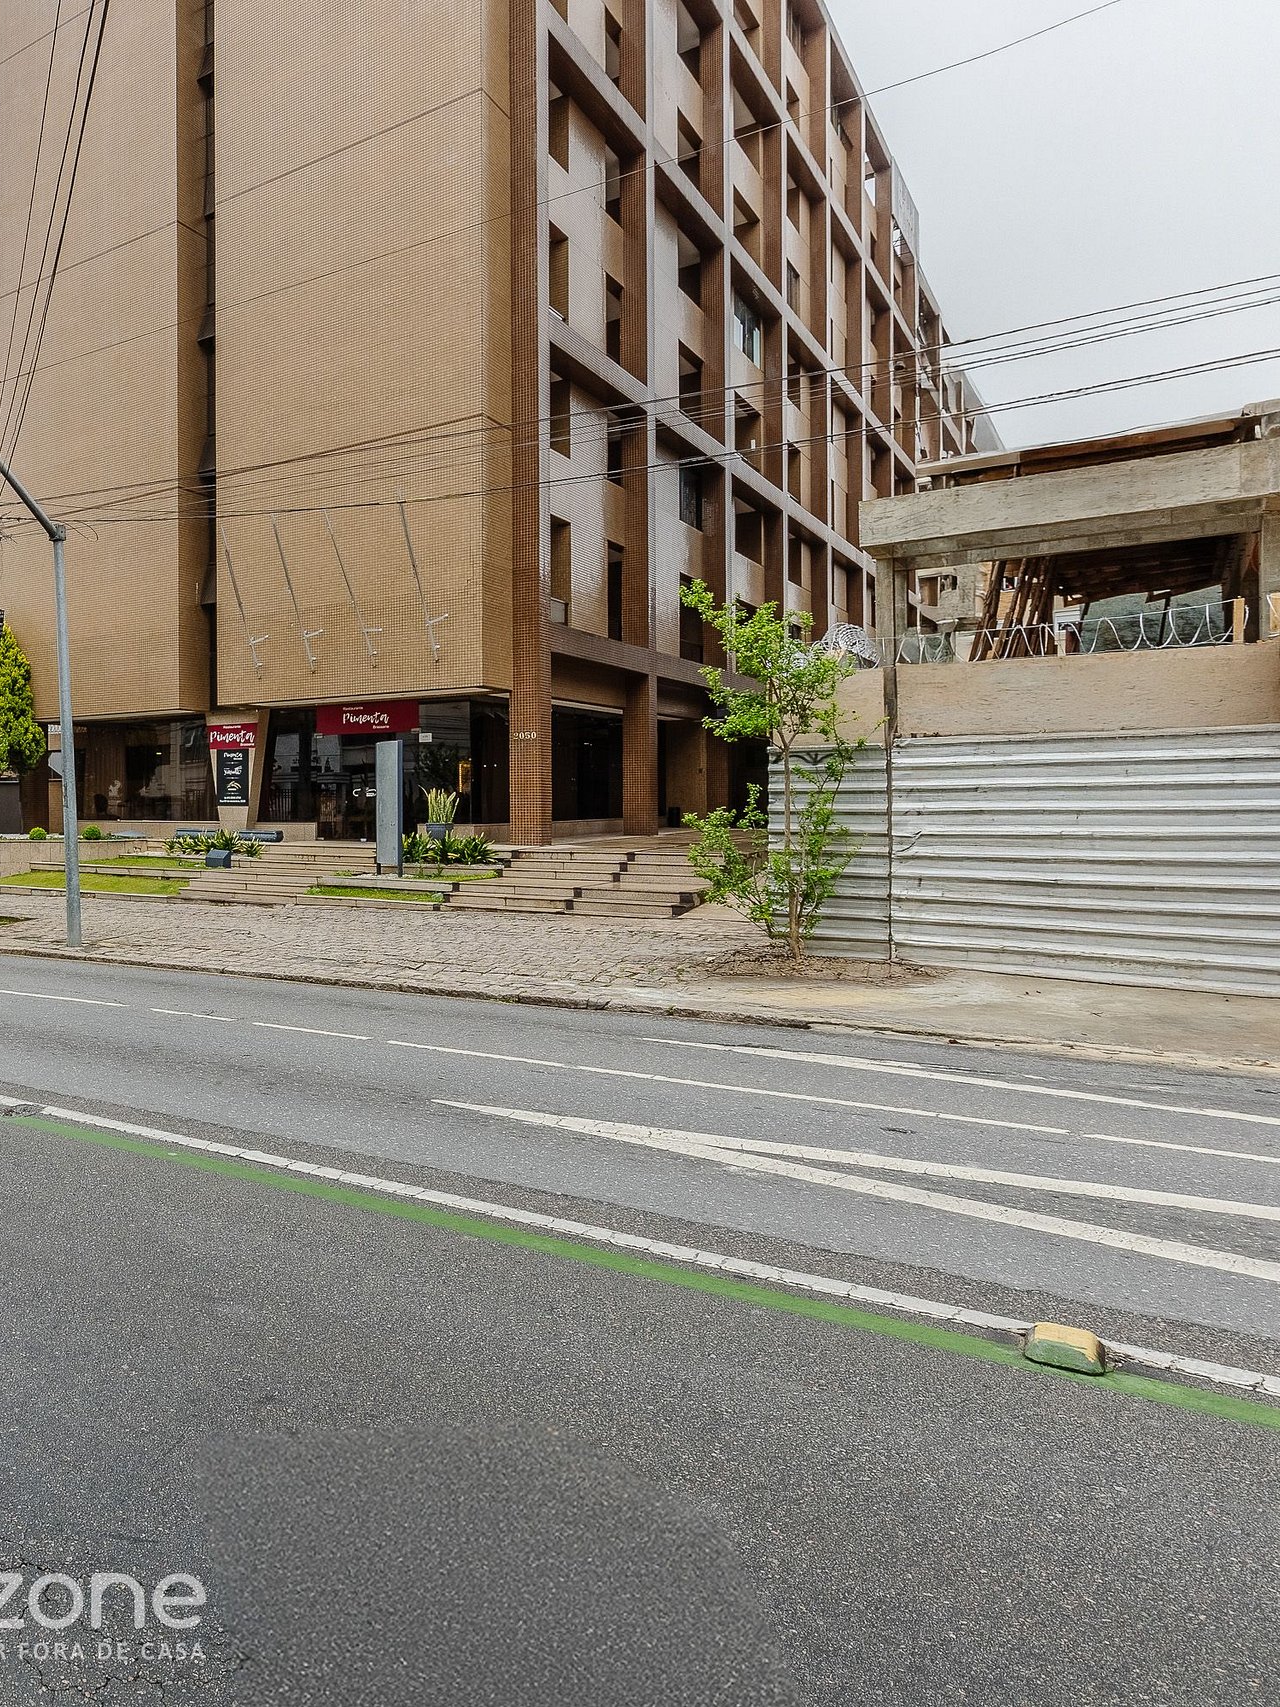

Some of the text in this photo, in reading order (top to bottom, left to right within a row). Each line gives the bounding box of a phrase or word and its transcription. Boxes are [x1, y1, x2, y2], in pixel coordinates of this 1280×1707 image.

[342, 711, 390, 724] Pimenta
[210, 730, 255, 743] Pimenta
[513, 731, 536, 739] 2050
